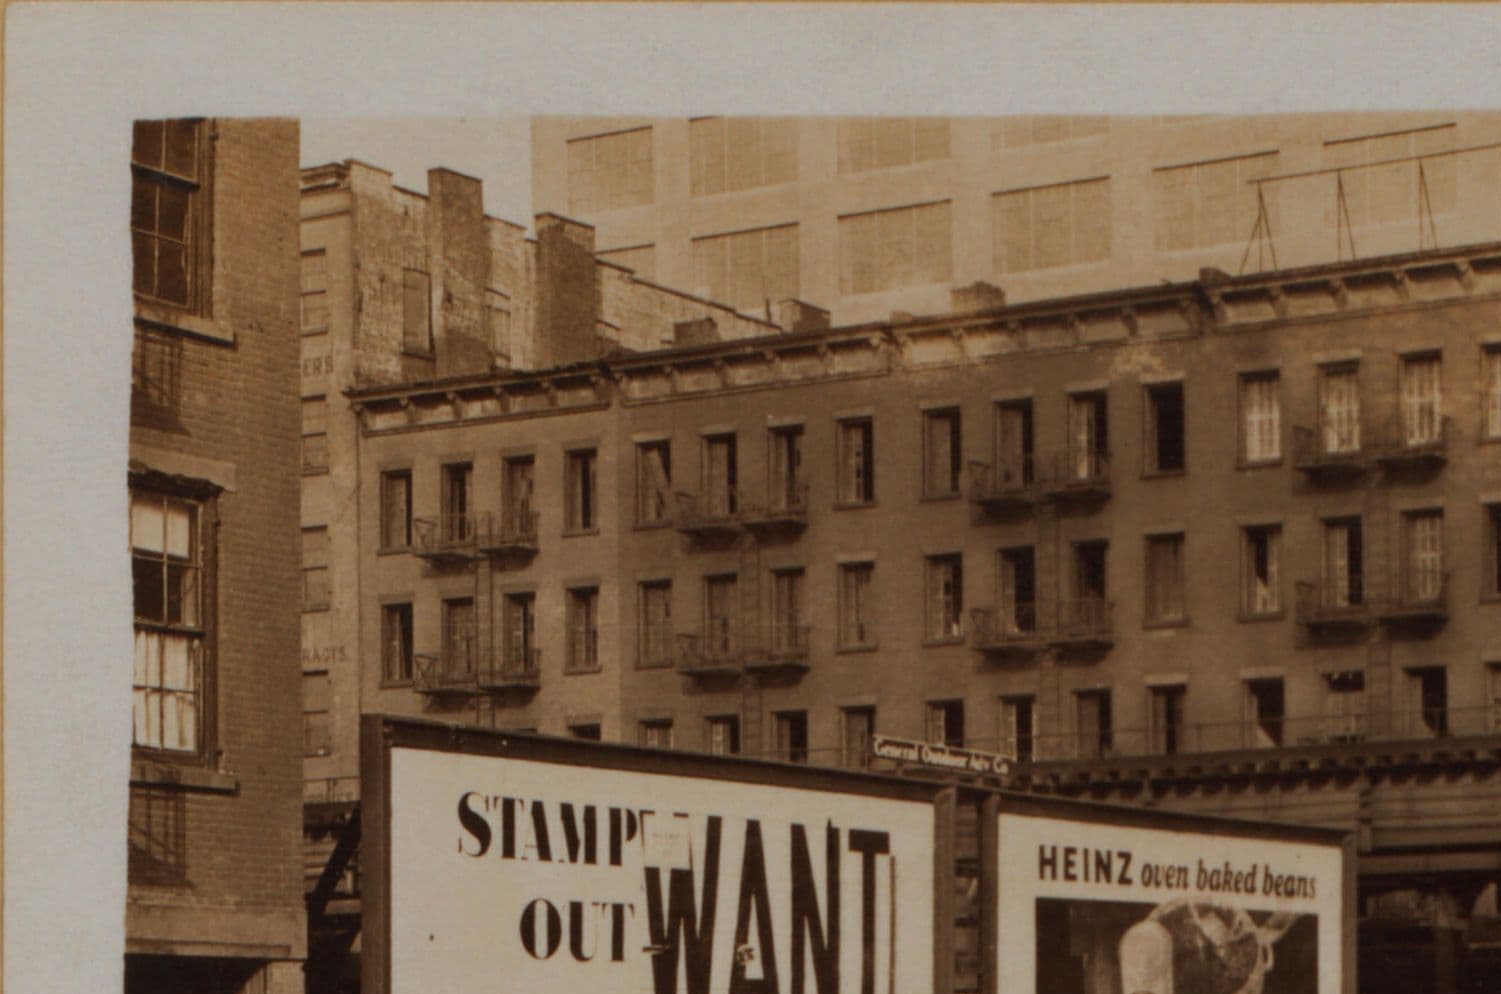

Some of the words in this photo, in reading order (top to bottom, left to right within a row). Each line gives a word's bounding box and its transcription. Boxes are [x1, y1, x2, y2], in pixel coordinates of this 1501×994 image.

[874, 737, 919, 761] General
[457, 791, 638, 867] STAMP
[1038, 844, 1134, 886] HEINZ
[1140, 862, 1190, 890] oven
[1196, 858, 1258, 895] baked
[1262, 864, 1317, 900] beans
[518, 898, 636, 962] OUT
